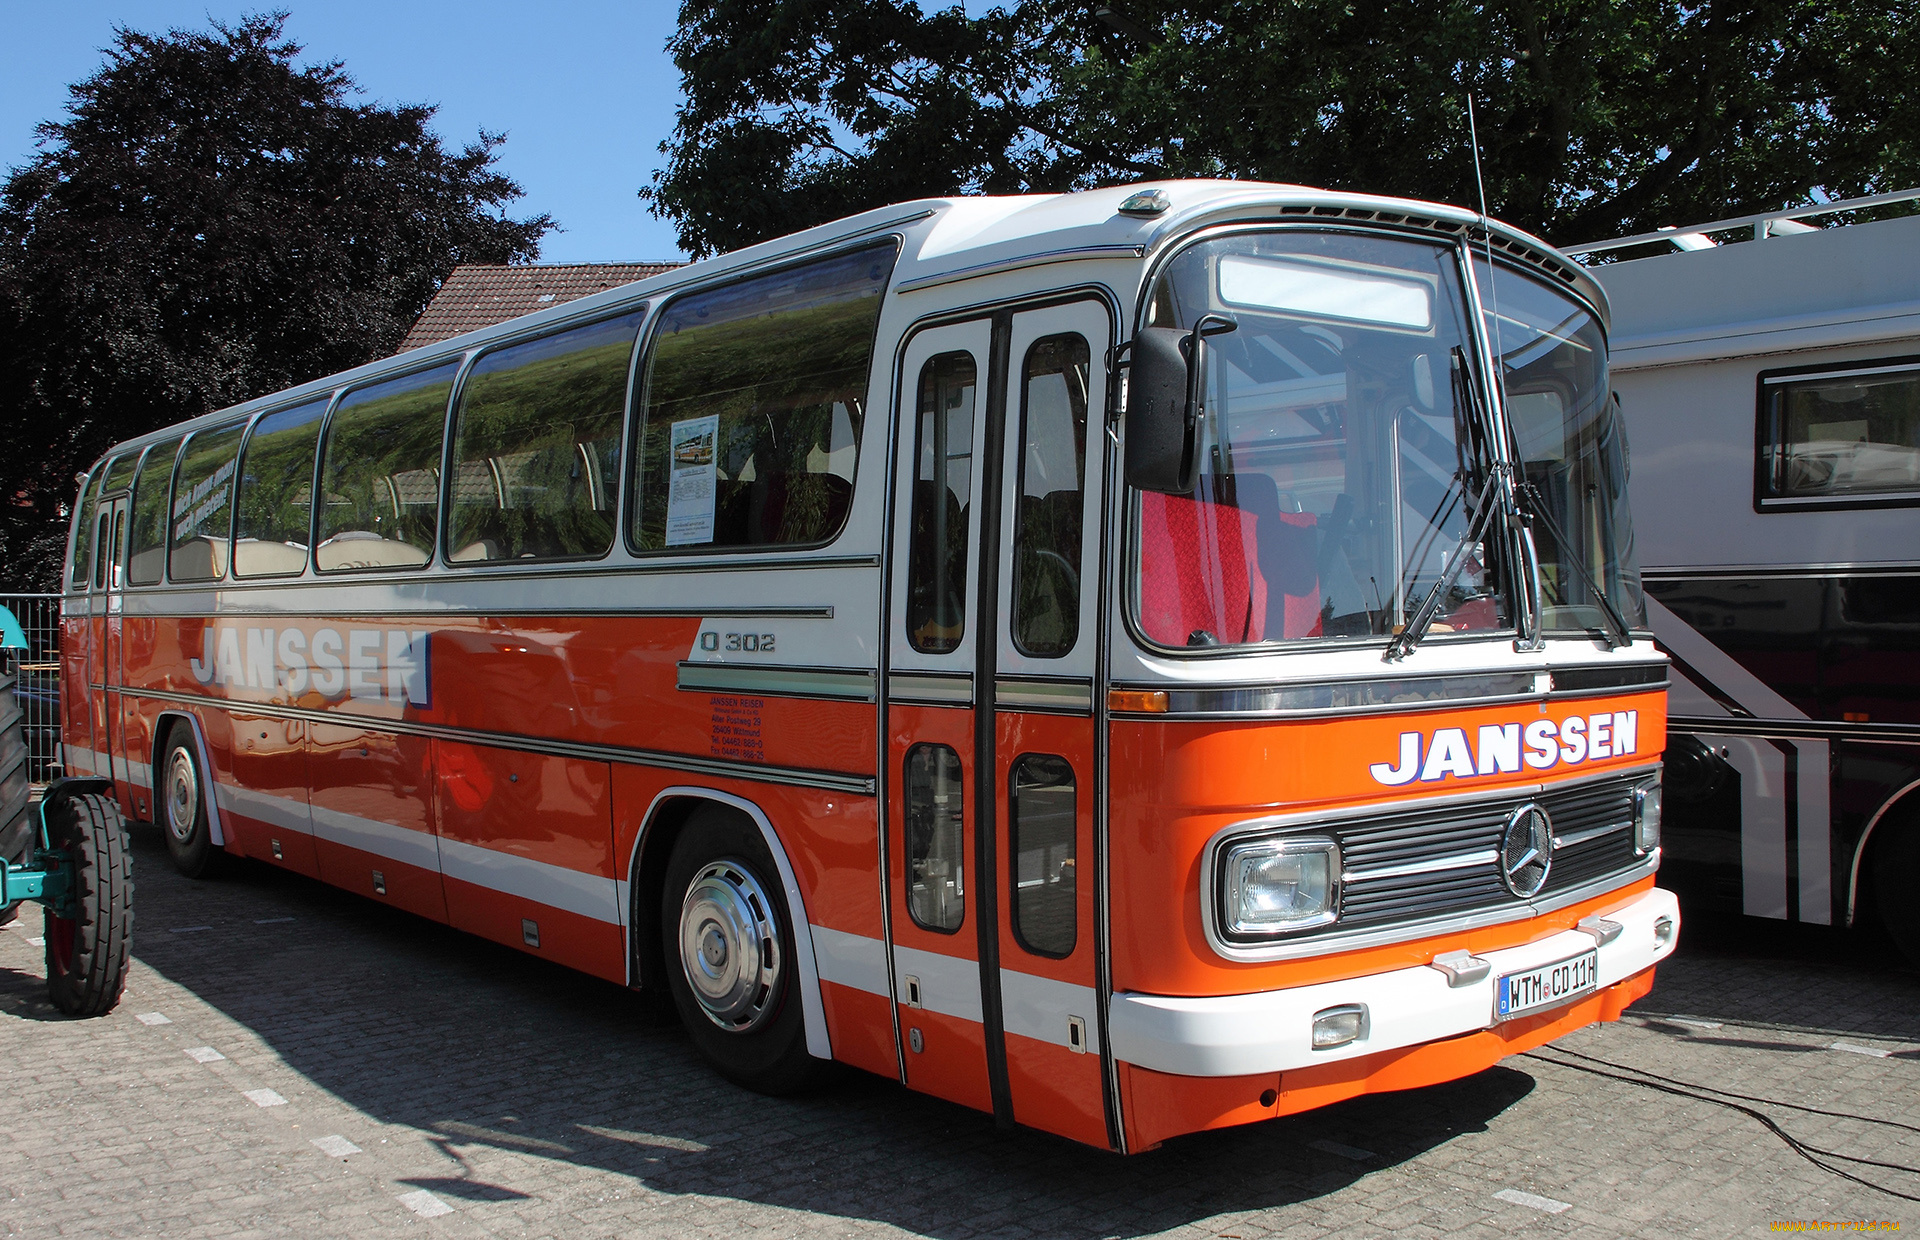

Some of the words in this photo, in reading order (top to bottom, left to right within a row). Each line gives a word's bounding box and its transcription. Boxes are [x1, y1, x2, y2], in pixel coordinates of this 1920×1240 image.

[725, 633, 775, 652] 302
[190, 627, 430, 707] JANSSEN
[710, 697, 738, 706] JANSSEN
[740, 698, 764, 708] REISEN
[1369, 710, 1638, 786] JANSSEN
[1510, 973, 1542, 1008] WTM
